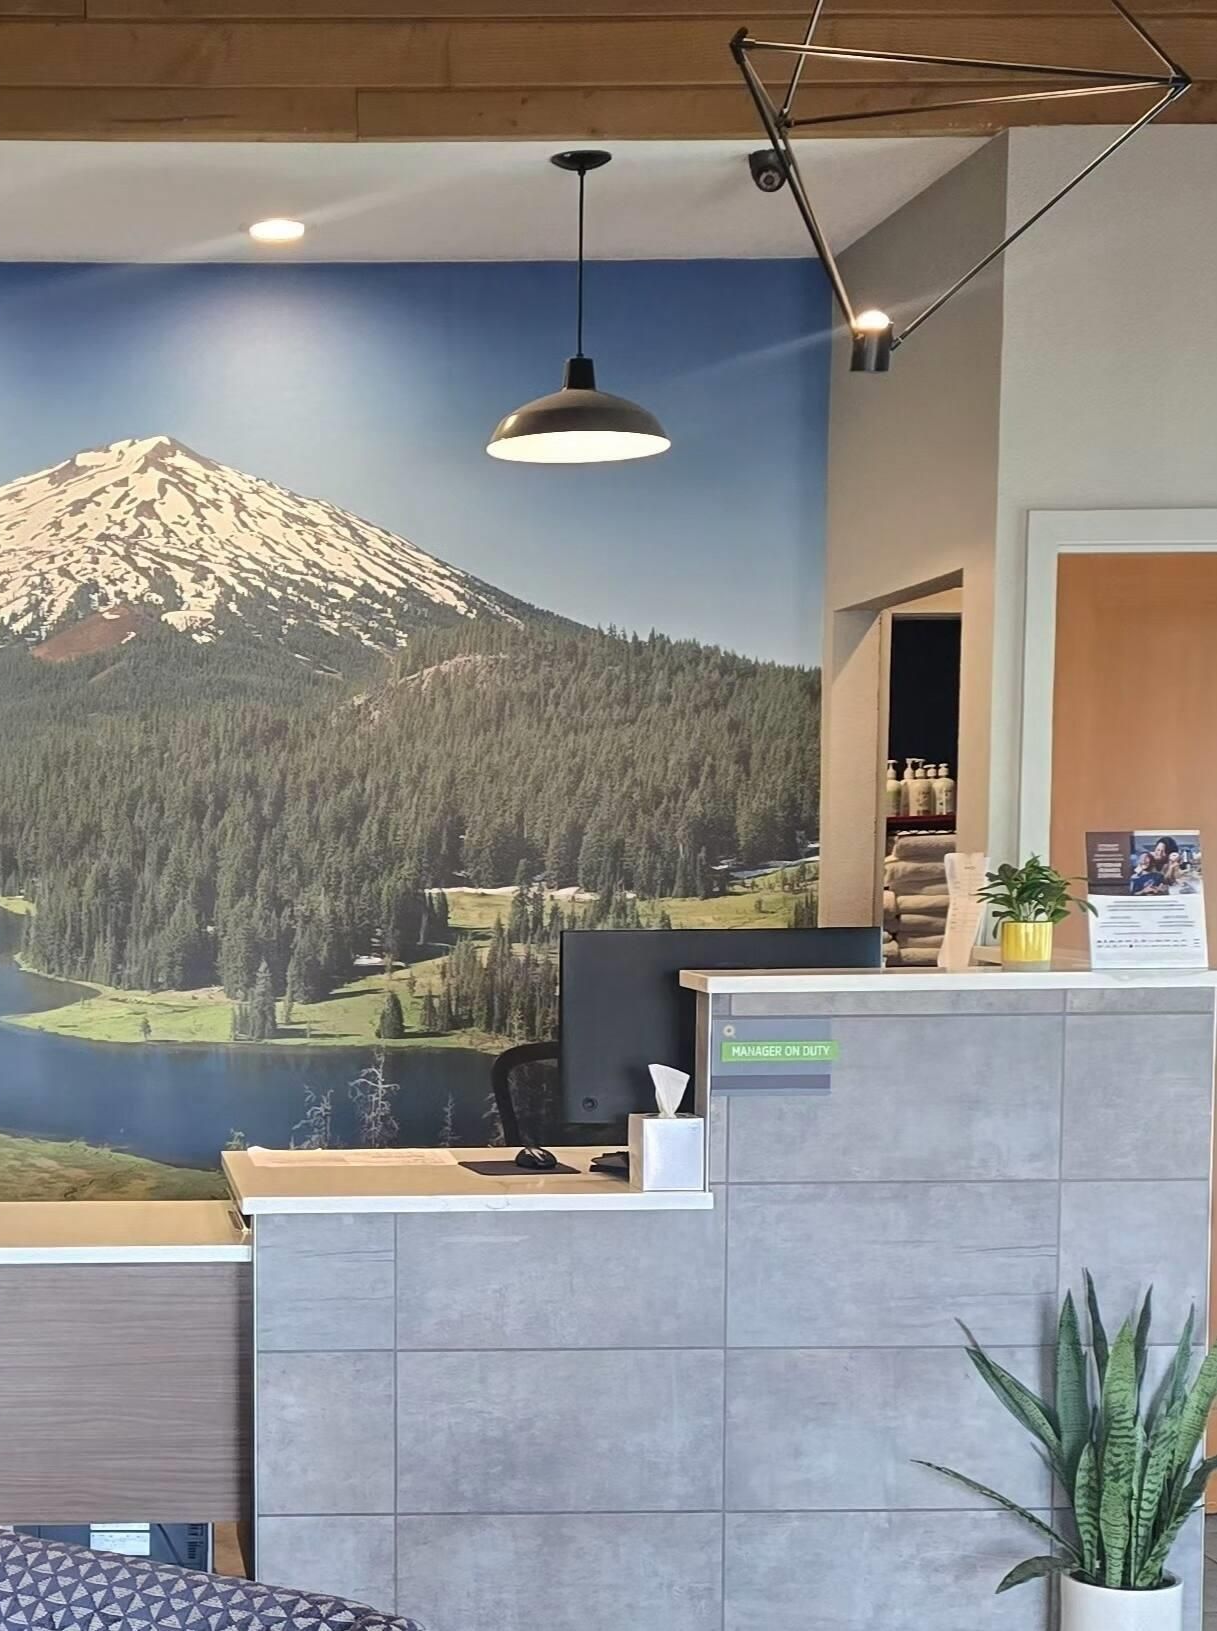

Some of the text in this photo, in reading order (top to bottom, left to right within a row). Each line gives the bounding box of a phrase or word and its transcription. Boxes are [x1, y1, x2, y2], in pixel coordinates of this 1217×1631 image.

[731, 1045, 831, 1057] MANAGER ON DUTY
